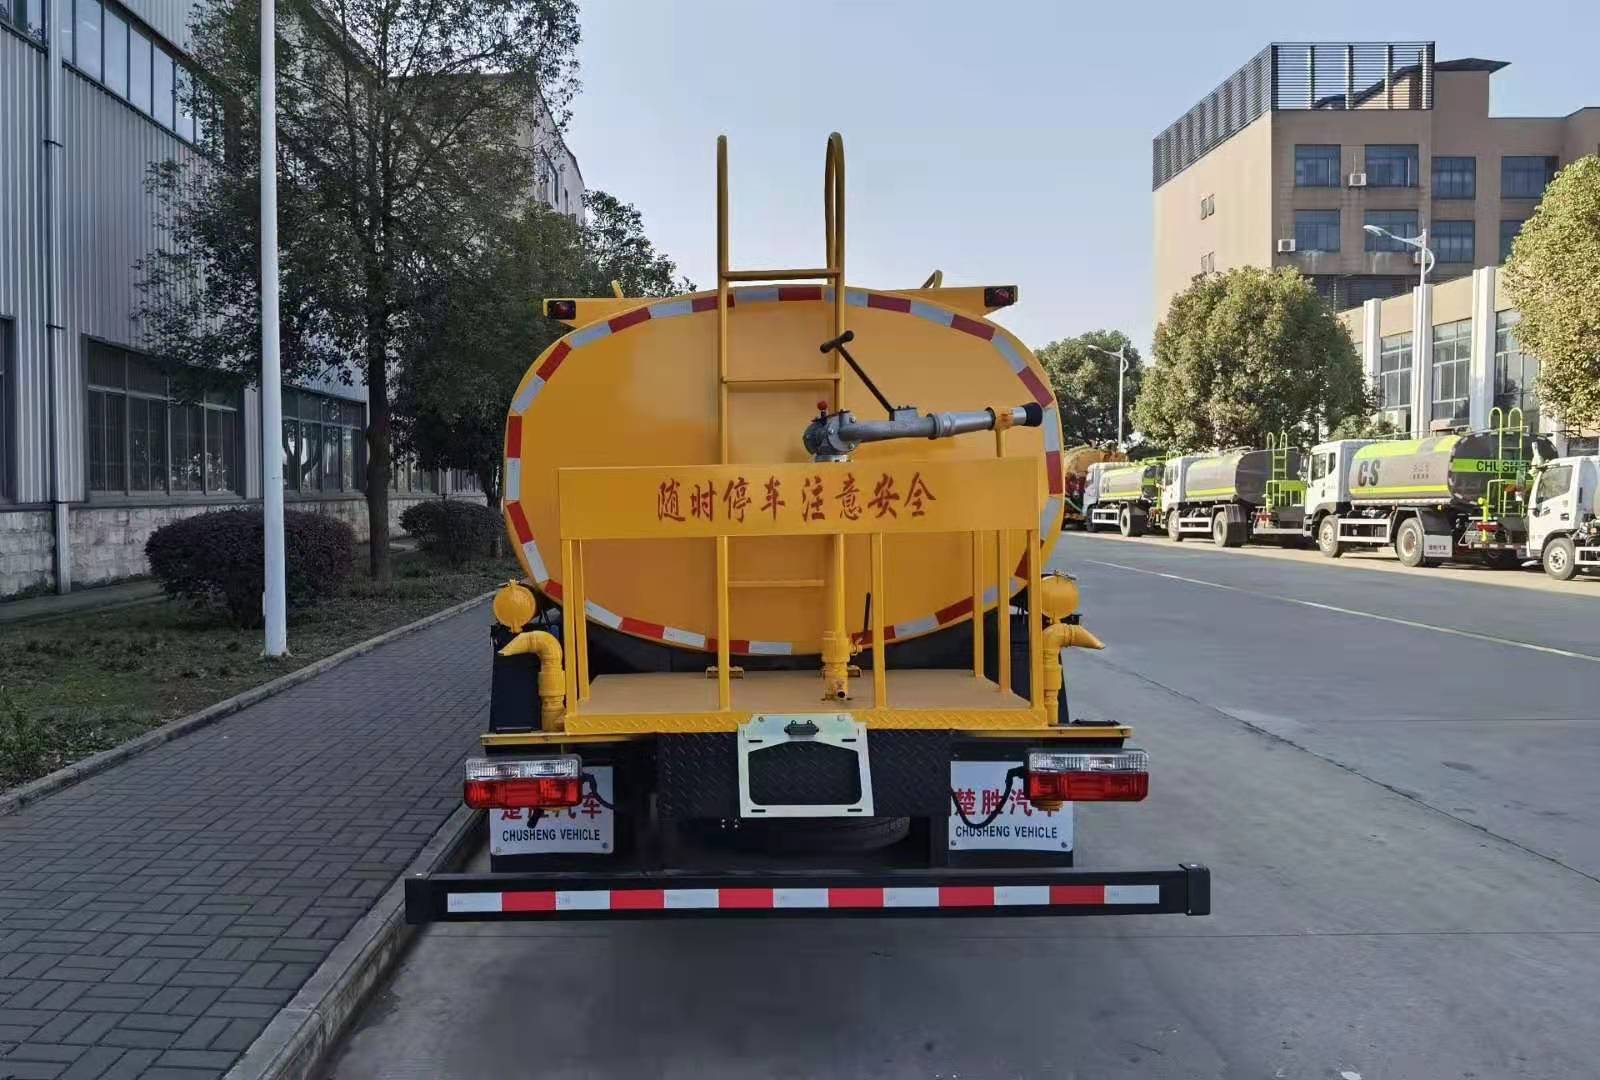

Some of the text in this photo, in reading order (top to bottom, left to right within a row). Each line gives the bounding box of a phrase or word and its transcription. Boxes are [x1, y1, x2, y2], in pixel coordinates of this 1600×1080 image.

[1358, 460, 1380, 487] CS
[657, 471, 937, 523] 随时停车注意安全
[955, 788, 1060, 817] 楚胜汽
[502, 828, 600, 842] CHUSHENG VEHICLE
[955, 825, 1057, 839] CHUSHENG VEHICLE
